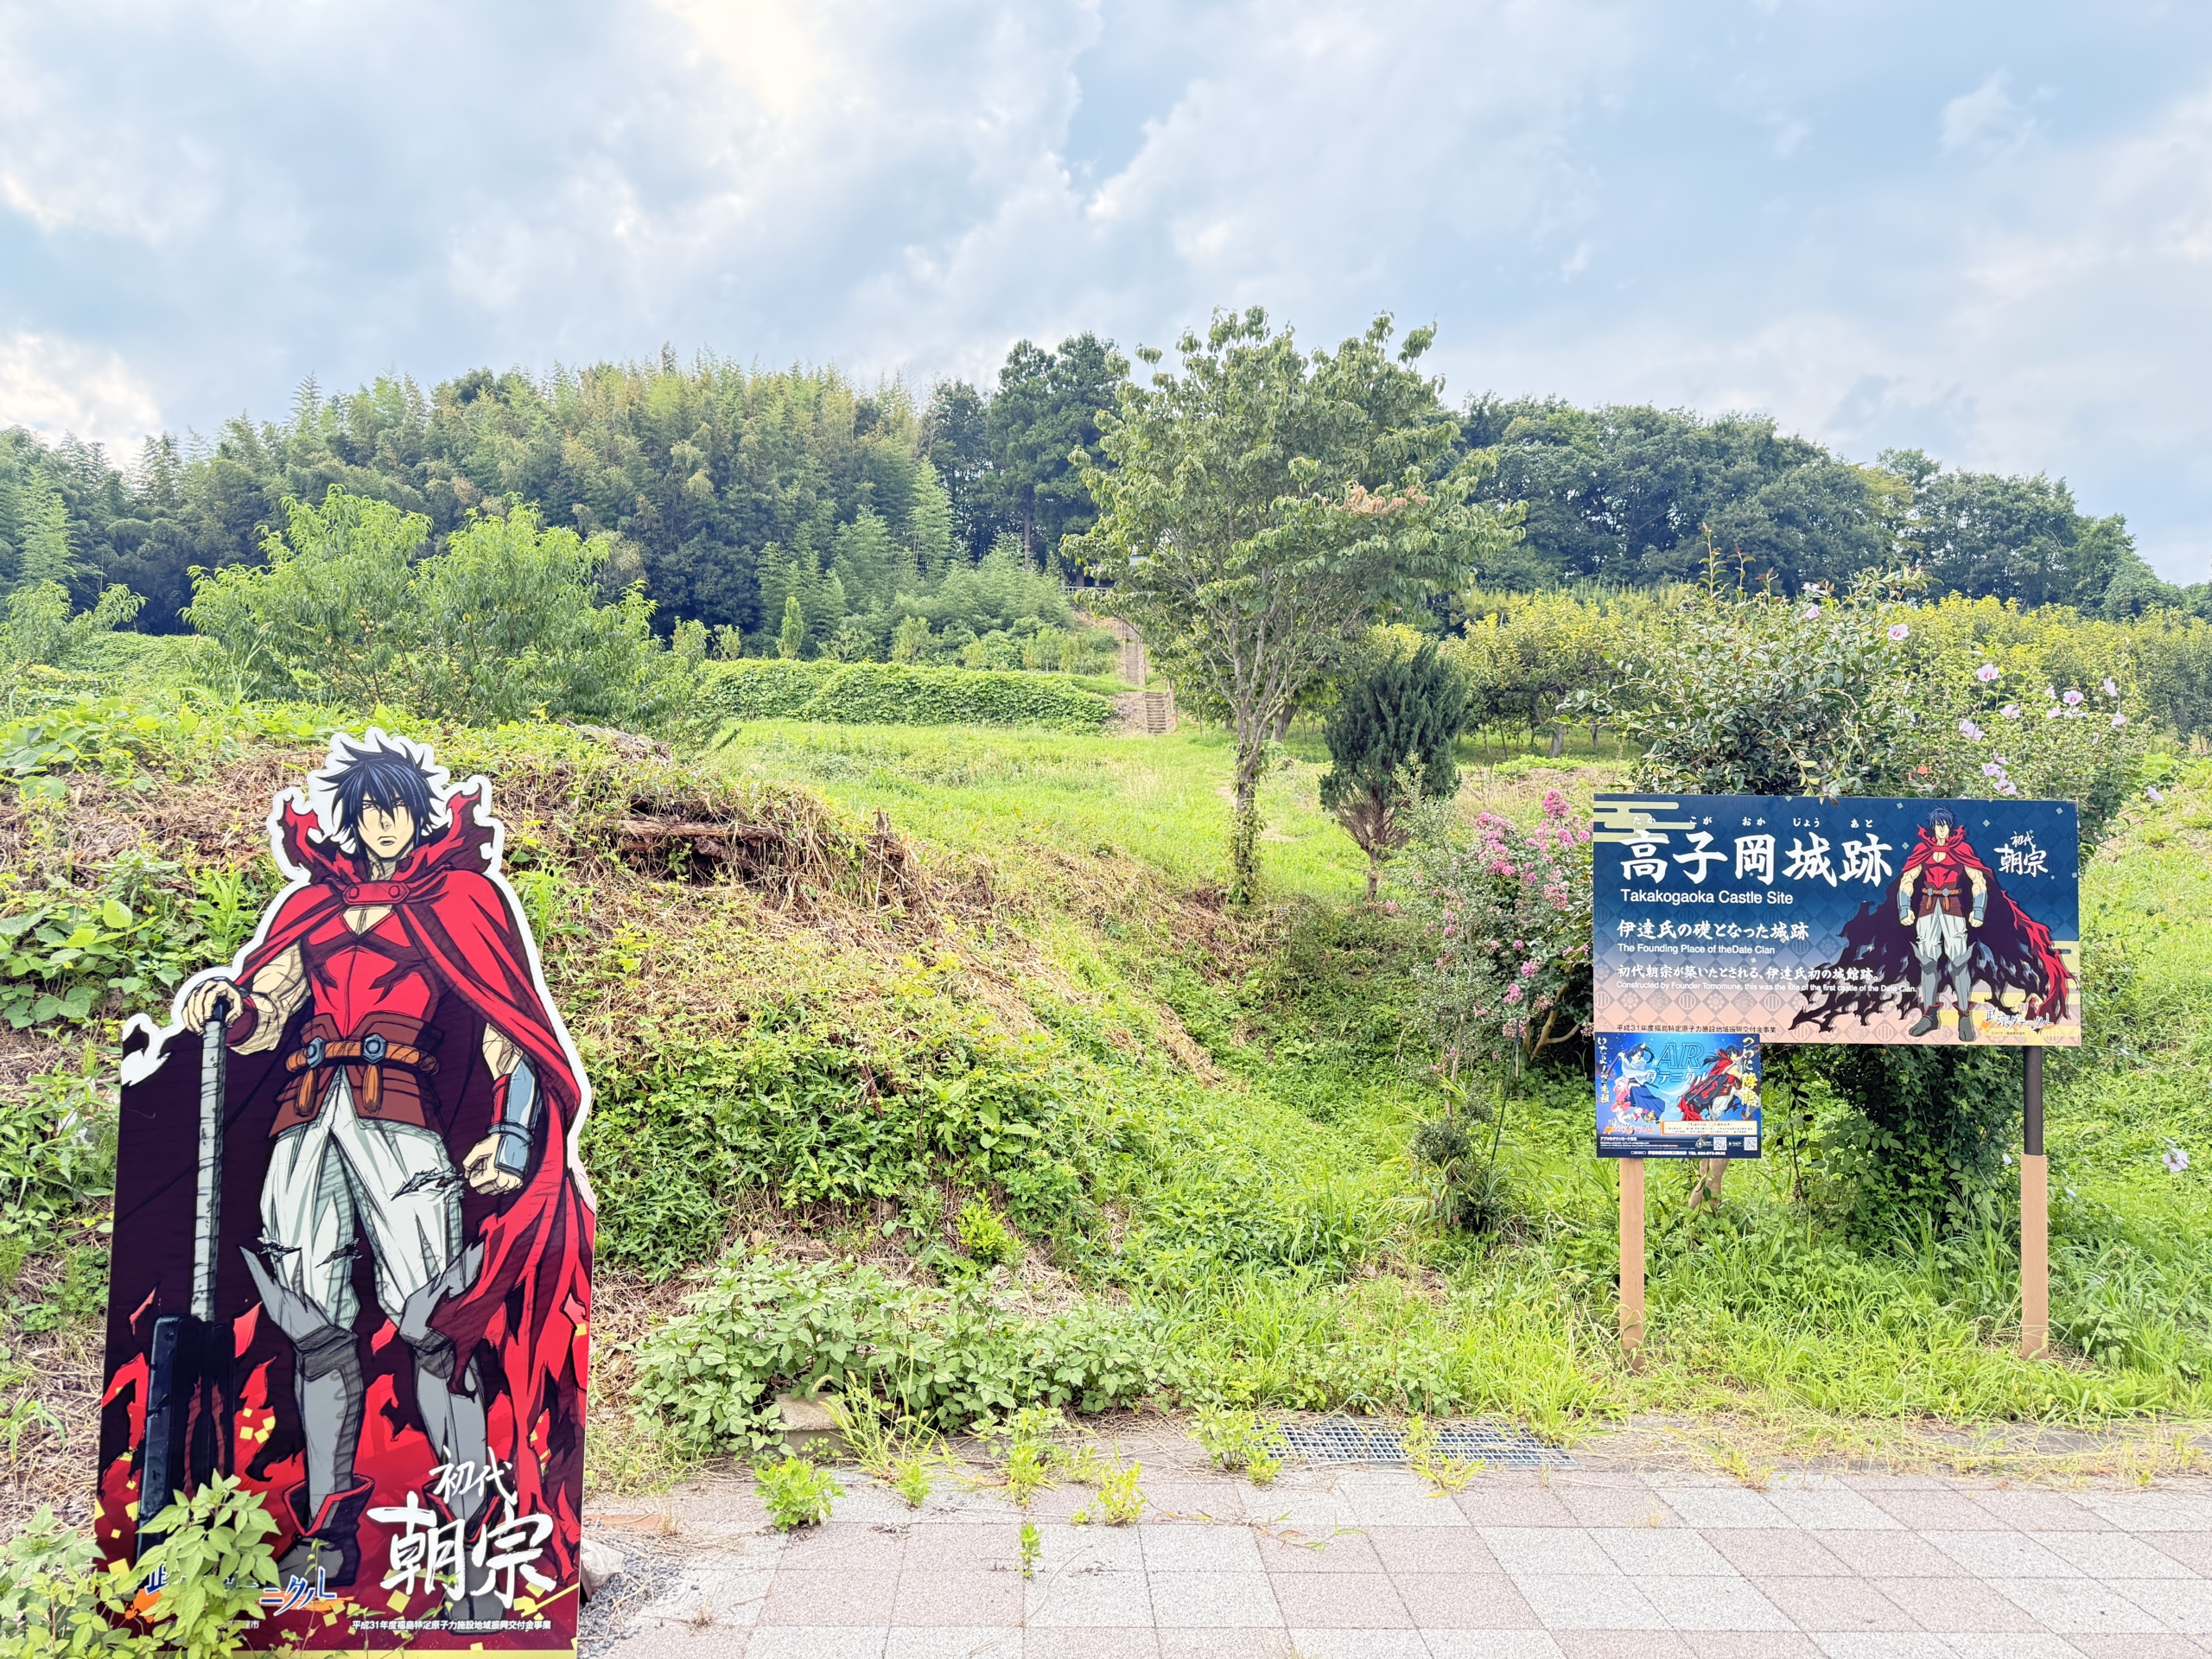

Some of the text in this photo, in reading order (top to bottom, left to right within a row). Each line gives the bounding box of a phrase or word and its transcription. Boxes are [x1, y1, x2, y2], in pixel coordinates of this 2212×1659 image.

[1632, 815, 1873, 828] たか こが おか じょう あと
[1618, 830, 1893, 887] 高子岡城跡
[1993, 843, 2049, 878] 朝宗
[1620, 888, 1793, 906] Takakogaoka Castle Site
[1616, 918, 1809, 941] 伊達氏の礎となった城跡
[1618, 943, 1635, 952] The
[1637, 944, 1678, 955] Founding
[1681, 944, 1706, 954] Place
[1707, 944, 1716, 954] of
[1754, 945, 1776, 955] Clan
[1617, 963, 1878, 982] 初代朝宗が築いたとされる、伊達氏初の城館跡。
[1616, 981, 1659, 989] Constructed
[1661, 982, 1669, 990] by
[1702, 982, 1743, 991] Tomomune,
[1656, 1043, 1704, 1069] AR
[429, 1445, 518, 1505] 初代
[366, 1491, 557, 1609] 朝宗
[352, 1619, 551, 1631] 平成31年度福島特定原子力施設地域振興交付金事業
